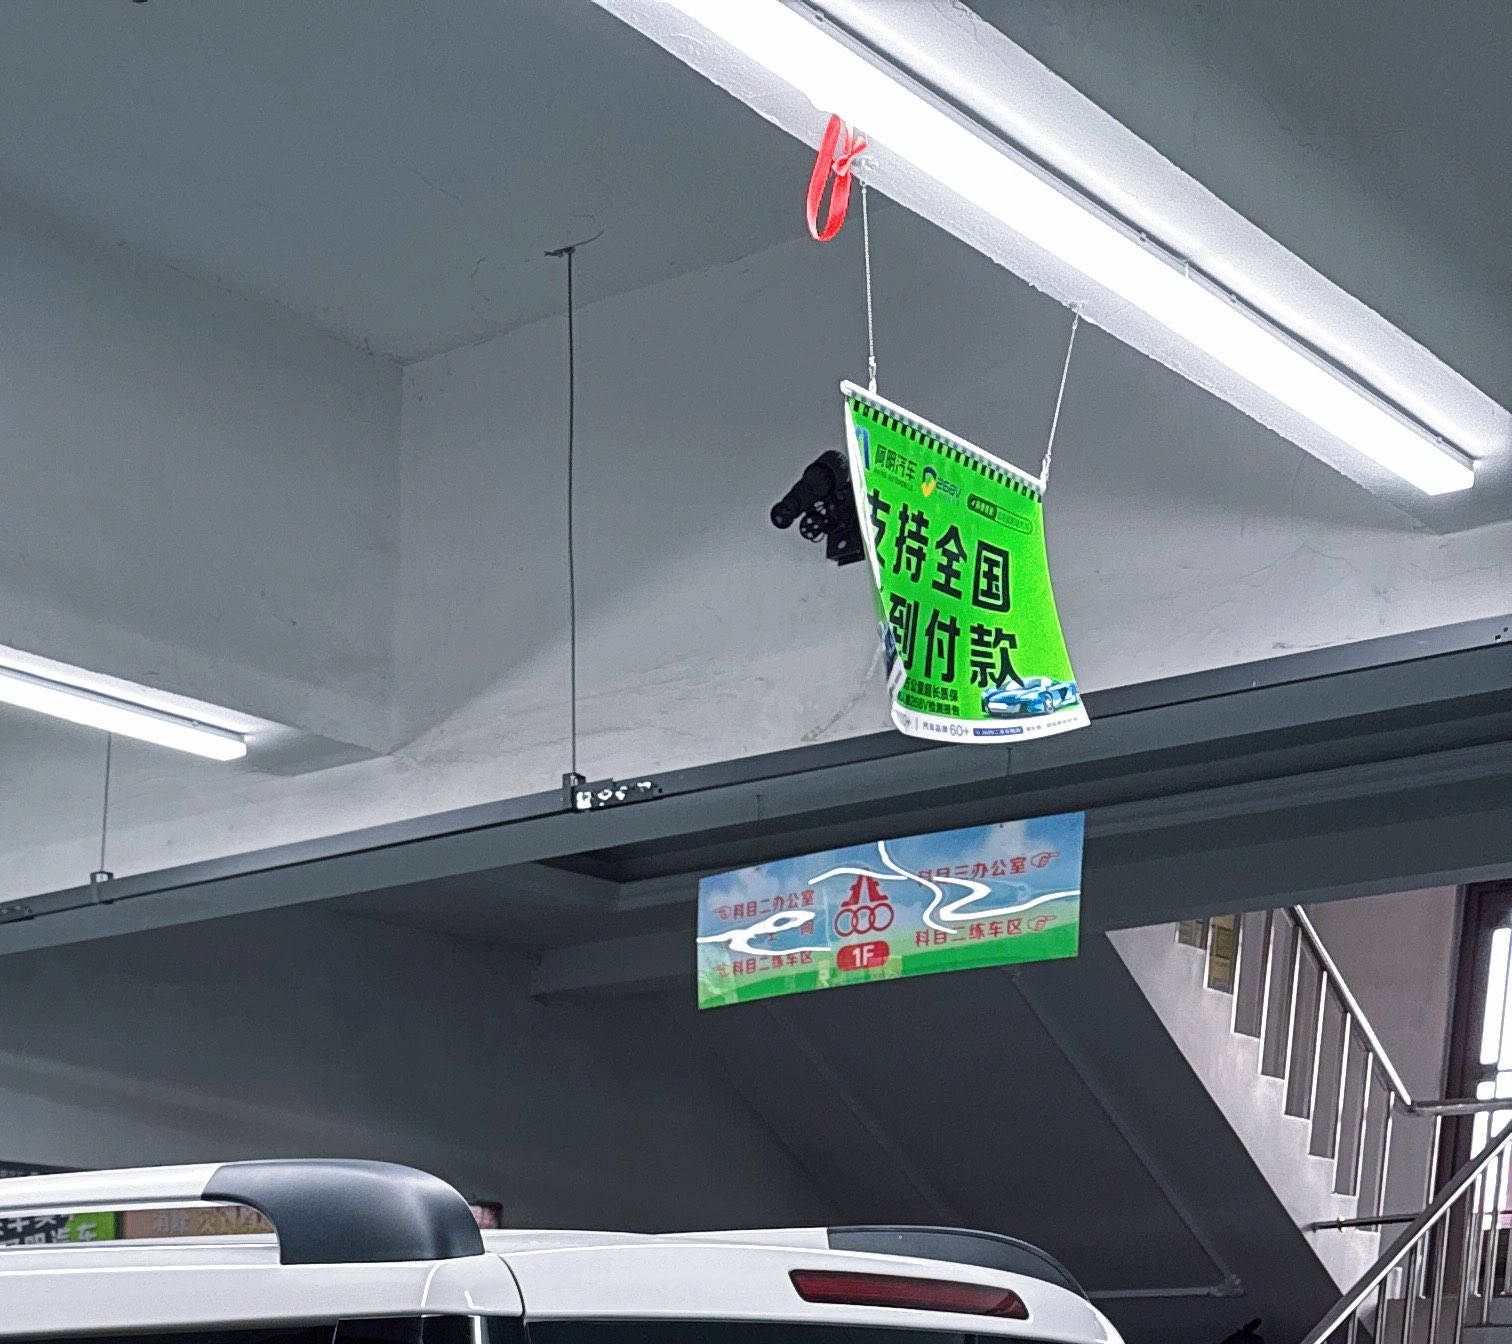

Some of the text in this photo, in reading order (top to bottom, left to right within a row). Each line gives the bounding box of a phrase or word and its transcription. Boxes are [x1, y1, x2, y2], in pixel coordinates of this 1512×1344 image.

[886, 591, 1025, 690] 到付款
[918, 854, 1029, 889] 科目三办公室
[733, 889, 815, 920] 科目二办公室
[914, 917, 1023, 948] 科目二练车区
[852, 944, 876, 969] 1F
